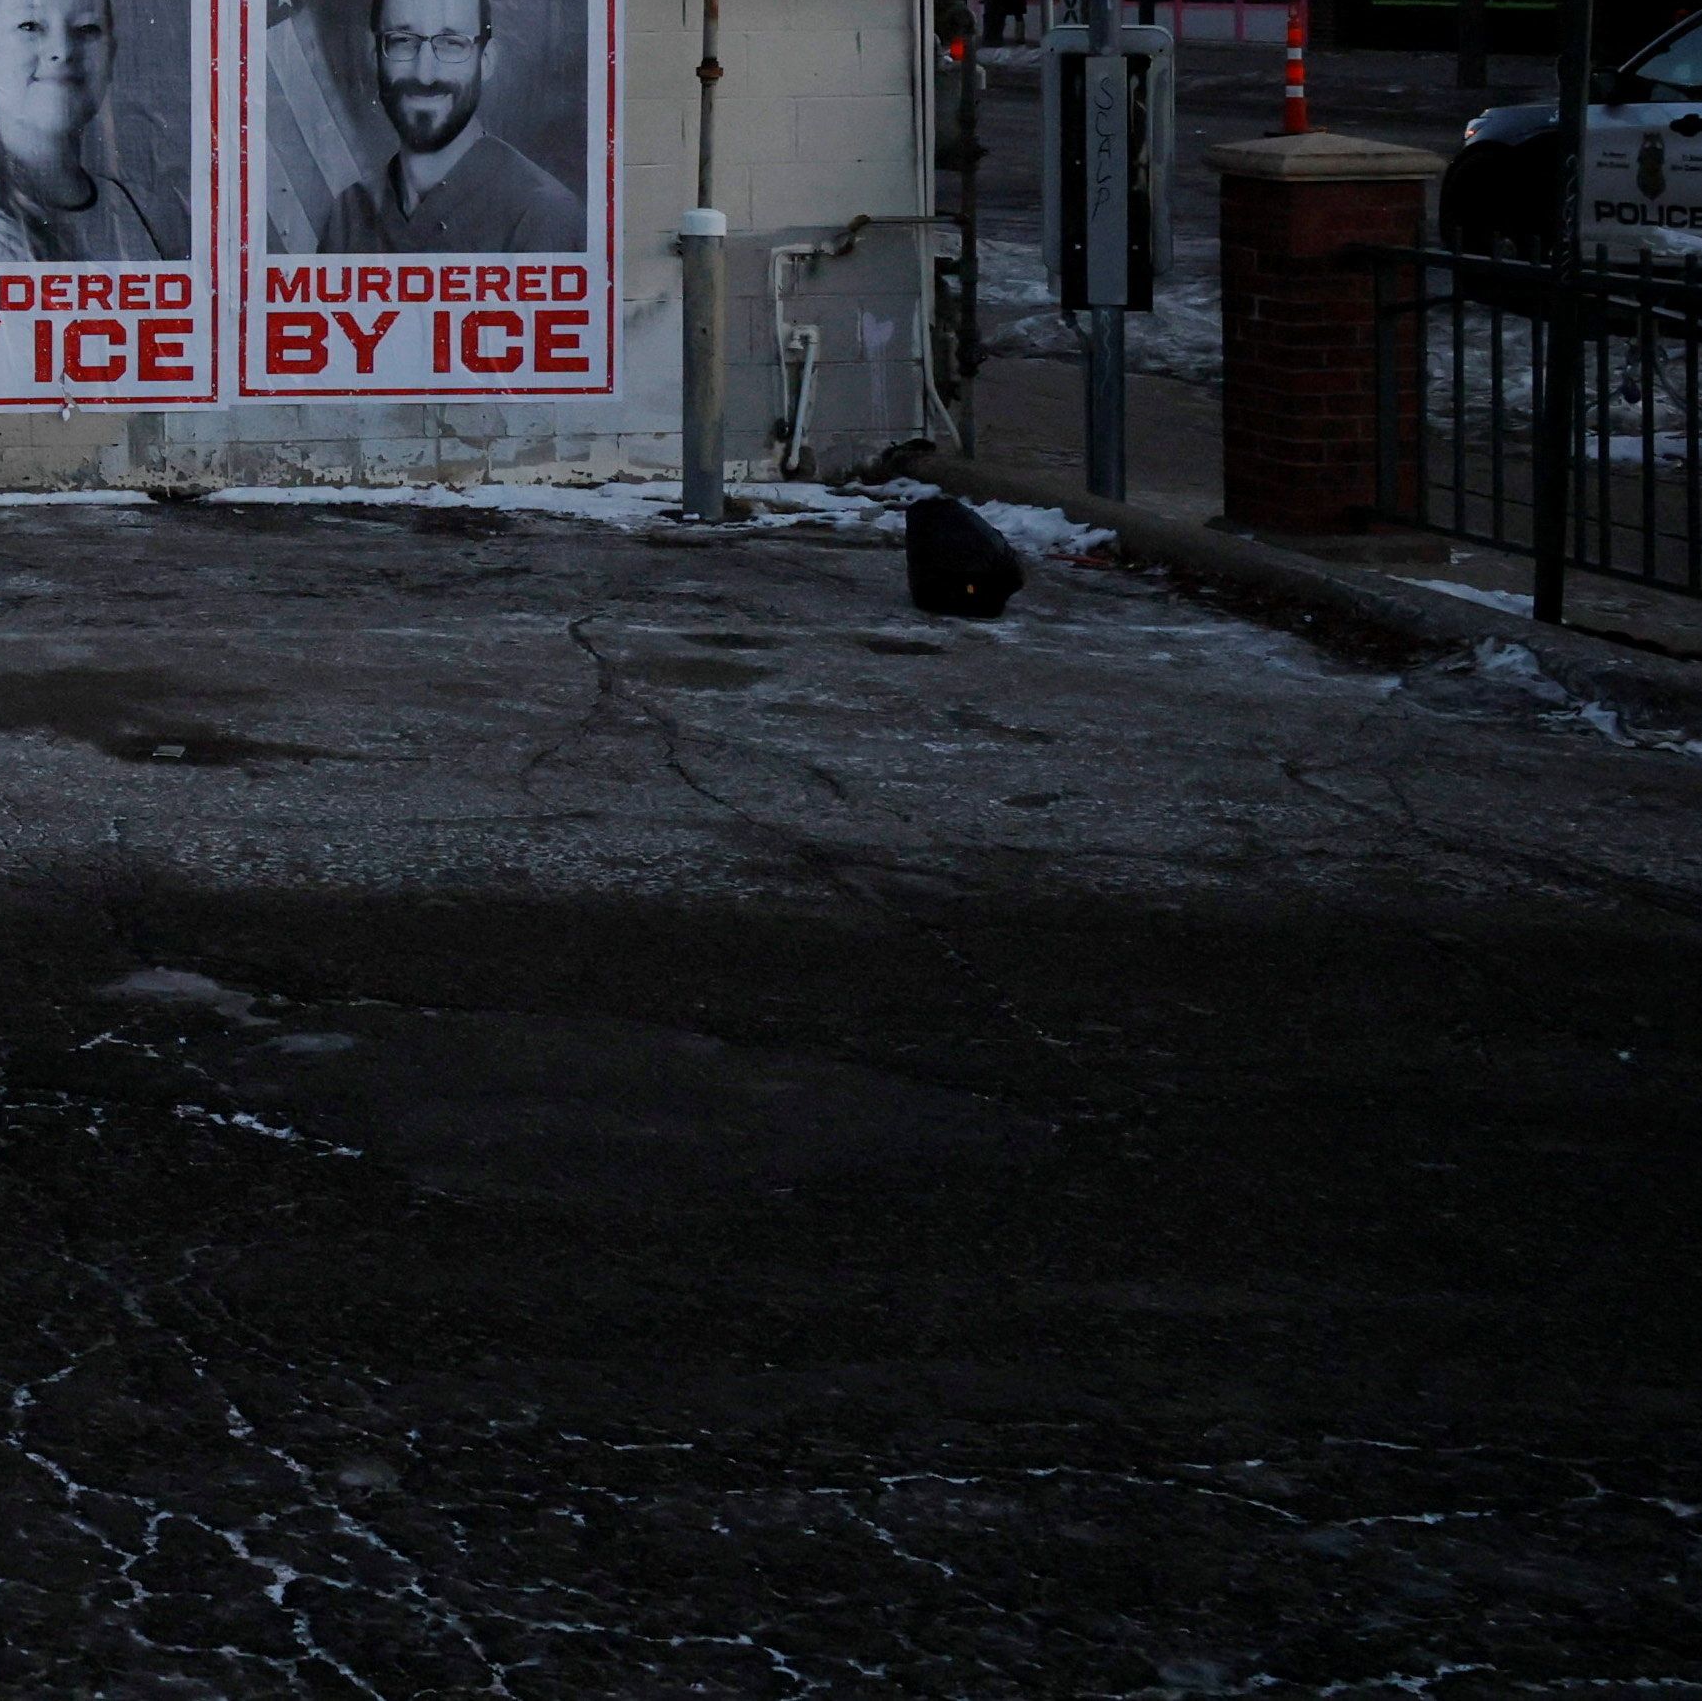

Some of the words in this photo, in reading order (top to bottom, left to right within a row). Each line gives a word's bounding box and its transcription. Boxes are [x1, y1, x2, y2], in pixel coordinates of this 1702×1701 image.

[1594, 200, 1702, 229] POLICE
[267, 266, 586, 302] MURDERED
[36, 319, 193, 382] ICE
[267, 312, 398, 373] BY
[434, 311, 589, 372] ICE
